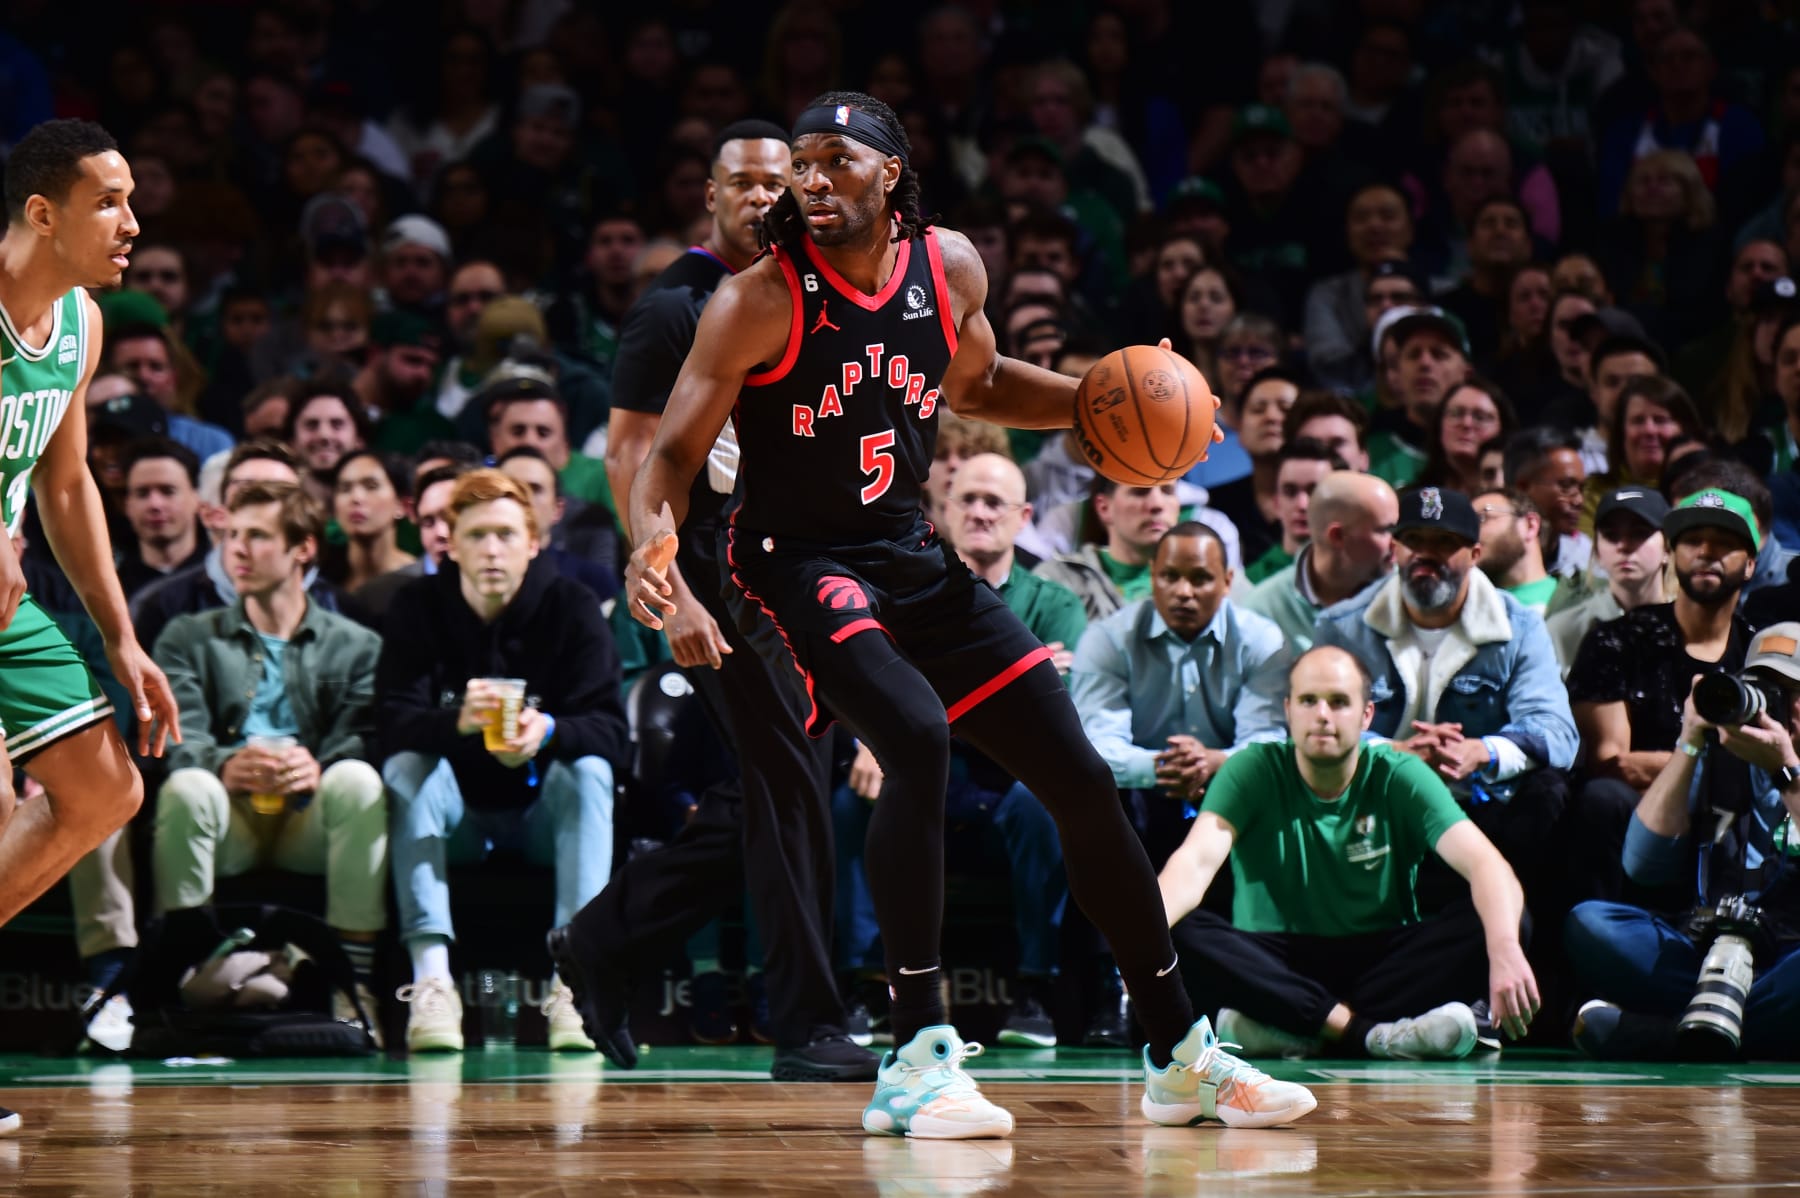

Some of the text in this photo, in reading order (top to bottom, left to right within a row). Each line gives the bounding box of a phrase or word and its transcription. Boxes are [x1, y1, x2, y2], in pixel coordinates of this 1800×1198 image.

[804, 273, 819, 293] 6
[902, 307, 934, 321] Sun Life
[793, 343, 939, 437] RAPTORS
[860, 429, 895, 505] 5
